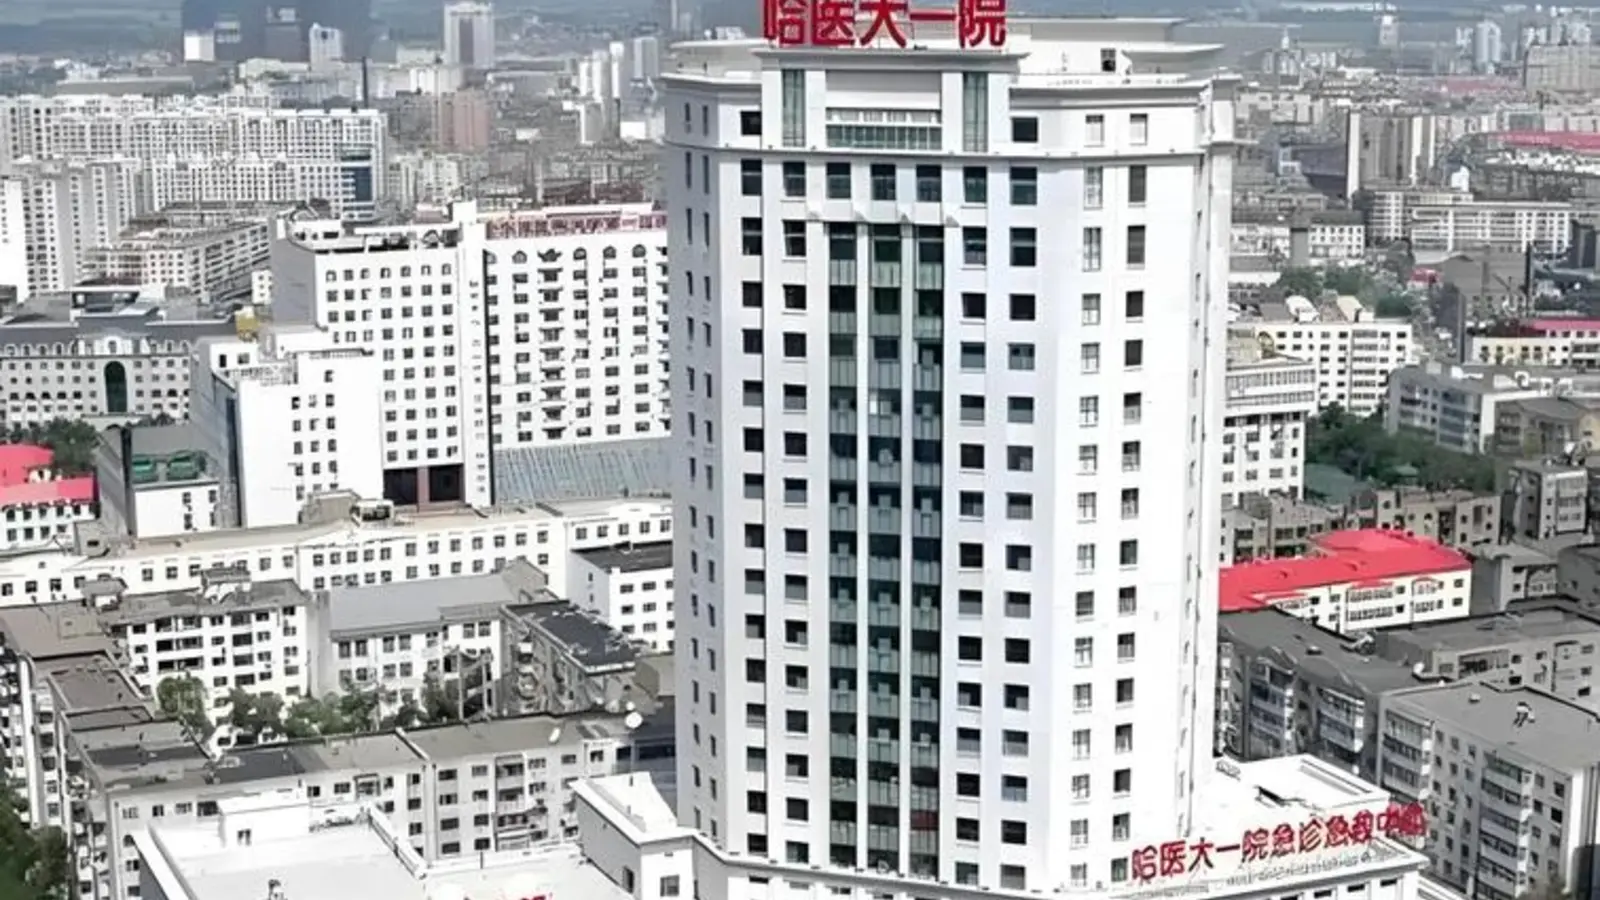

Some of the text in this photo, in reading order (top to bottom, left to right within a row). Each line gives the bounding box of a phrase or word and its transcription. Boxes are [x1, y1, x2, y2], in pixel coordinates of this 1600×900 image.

[763, 0, 1007, 48] 哈医大一院
